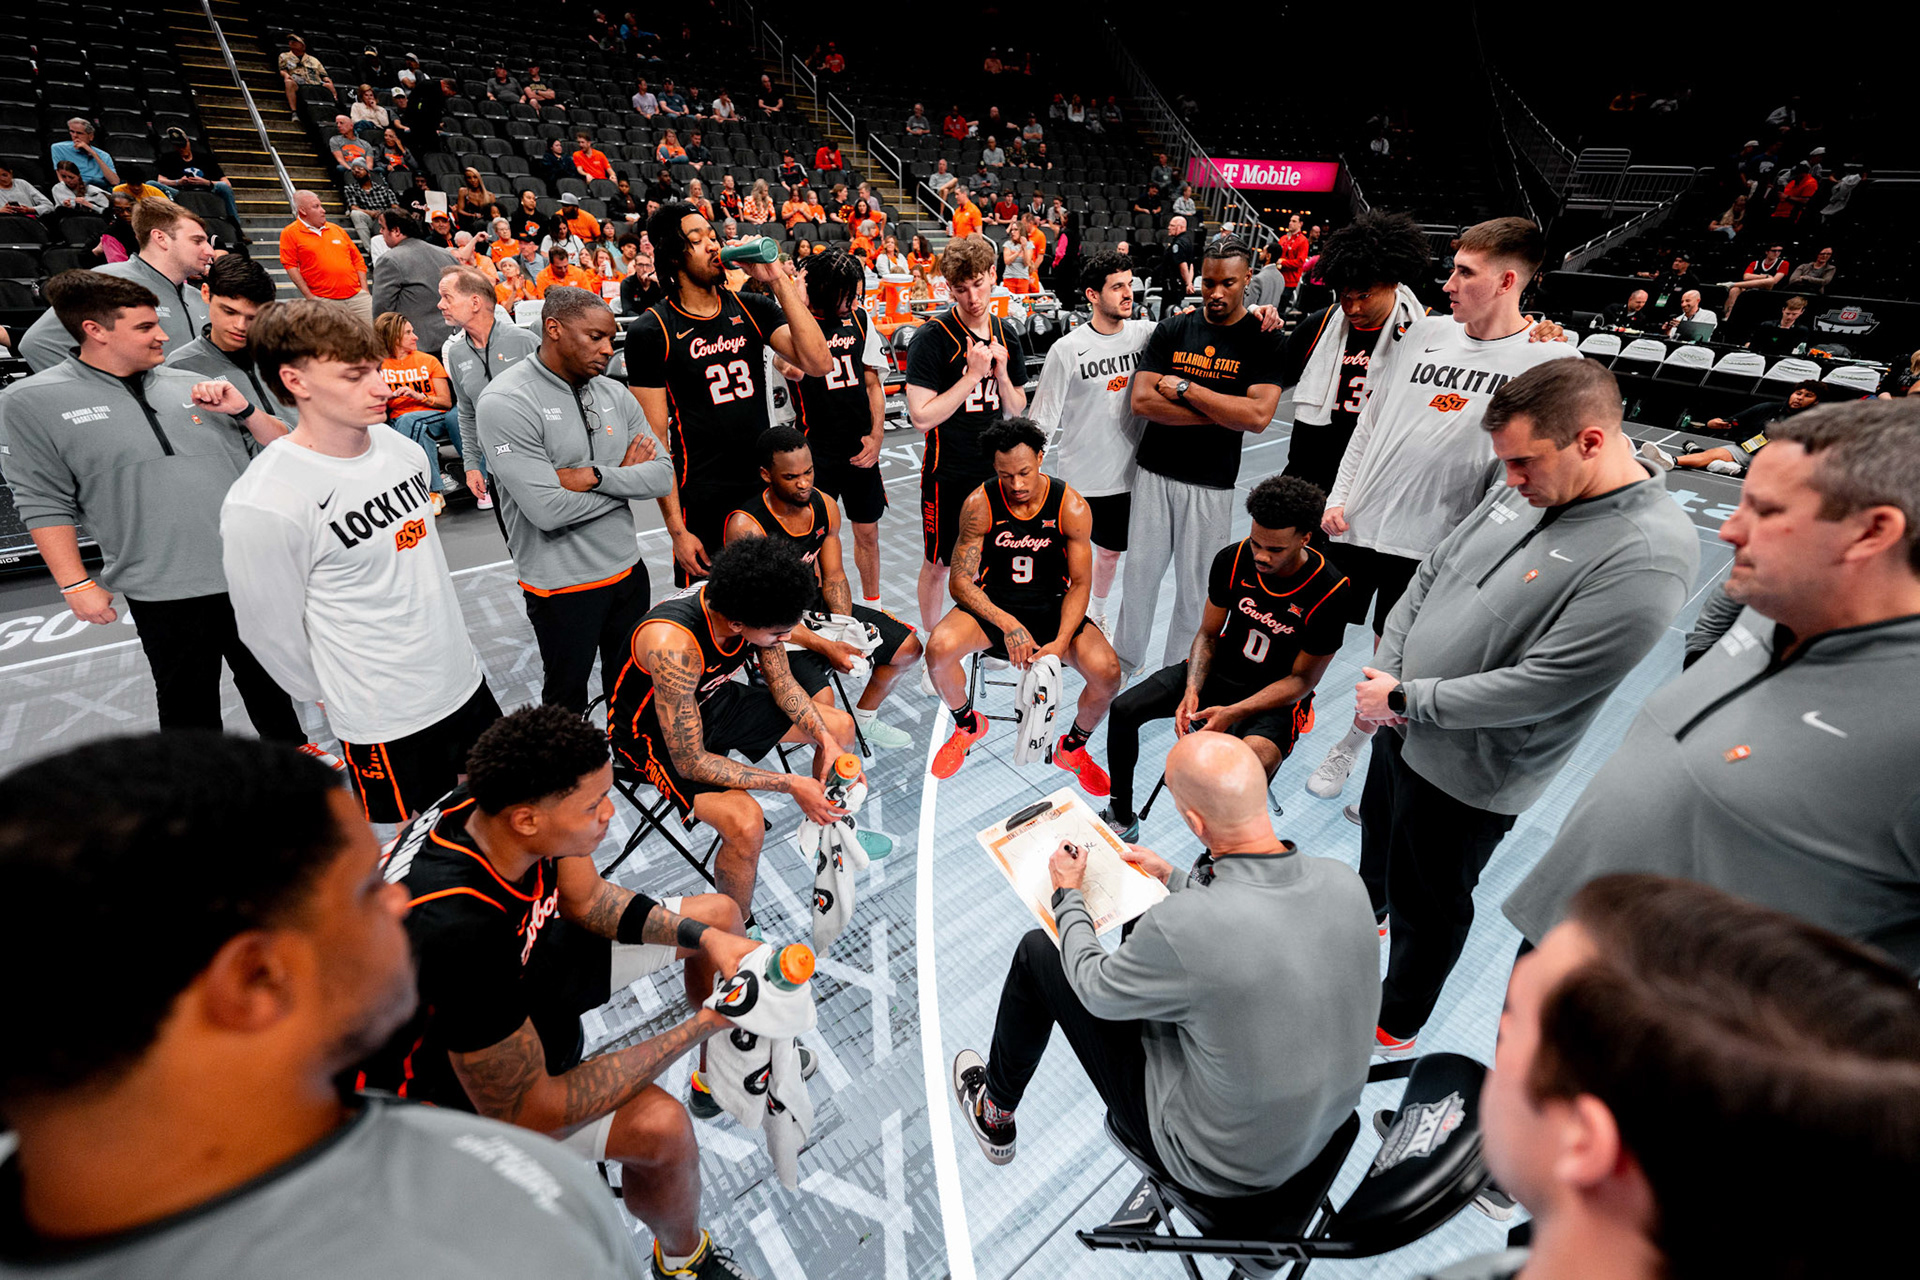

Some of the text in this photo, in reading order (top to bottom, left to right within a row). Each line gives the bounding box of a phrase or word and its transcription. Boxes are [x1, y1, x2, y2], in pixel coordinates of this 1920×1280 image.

[1240, 164, 1302, 186] Mobile
[690, 334, 747, 359] Cowboys
[826, 333, 857, 350] wboys
[825, 354, 860, 390] 21
[1080, 357, 1118, 380] LOCK
[1119, 354, 1130, 373] IT
[1213, 358, 1241, 374] STATE
[1410, 362, 1466, 390] LOCK
[1462, 369, 1490, 393] IT
[705, 359, 754, 405] 23
[965, 378, 1000, 413] 24
[1428, 393, 1470, 413] OSU
[329, 491, 404, 549] LOCK
[392, 480, 419, 514] IT
[924, 500, 935, 534] POKES
[395, 517, 427, 552] OSU
[995, 531, 1052, 552] Cowboys
[1011, 555, 1034, 584] 9
[1238, 597, 1295, 635] Cowboys
[1242, 628, 1271, 664] 0
[645, 759, 673, 801] POKES
[990, 1146, 1016, 1157] NIK
